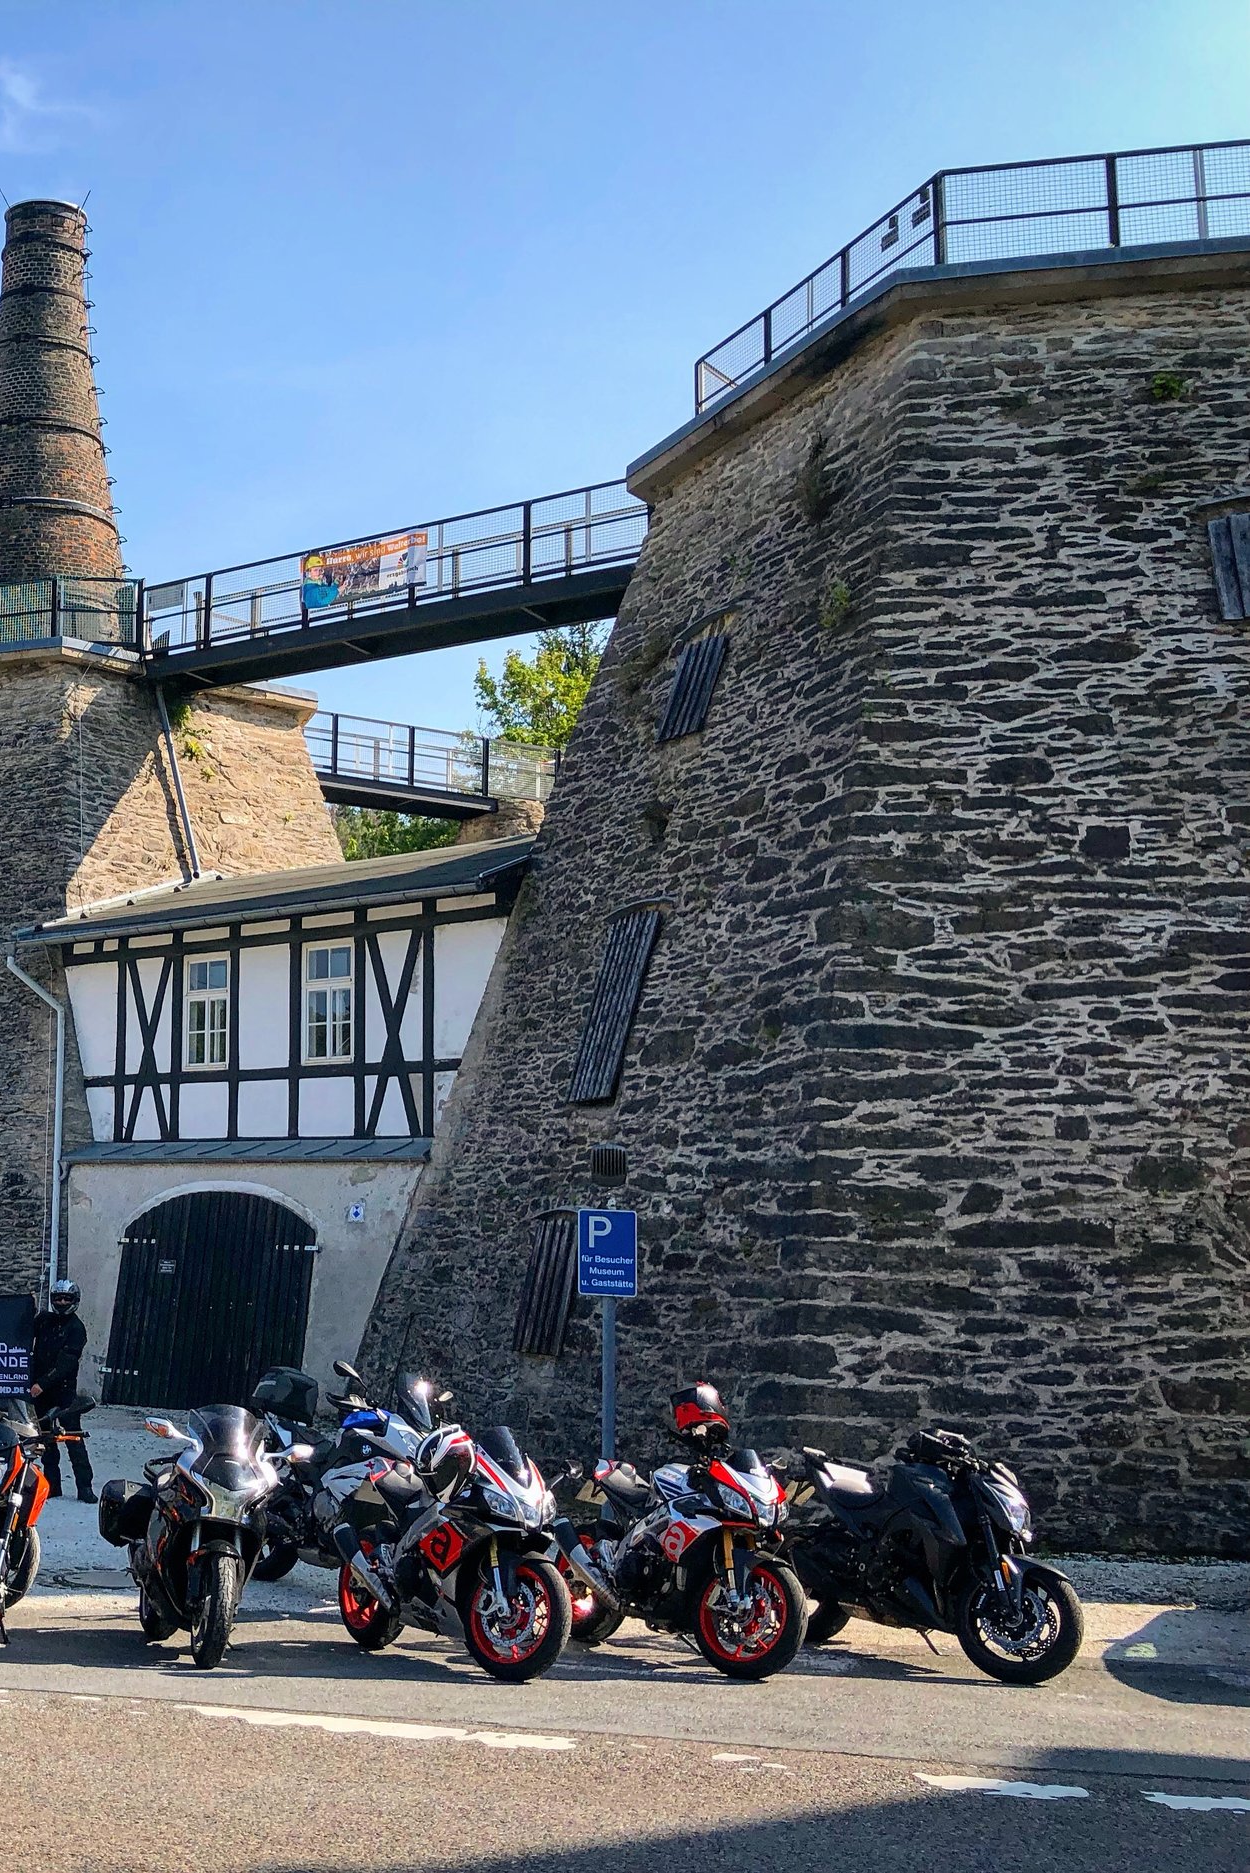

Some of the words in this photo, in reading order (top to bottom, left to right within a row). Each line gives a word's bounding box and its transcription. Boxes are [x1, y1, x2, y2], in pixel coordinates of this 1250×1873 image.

[588, 1215, 612, 1248] P
[581, 1254, 593, 1263] für
[594, 1255, 634, 1264] Besucher
[589, 1266, 625, 1276] Museum
[591, 1278, 634, 1288] Gaststätte
